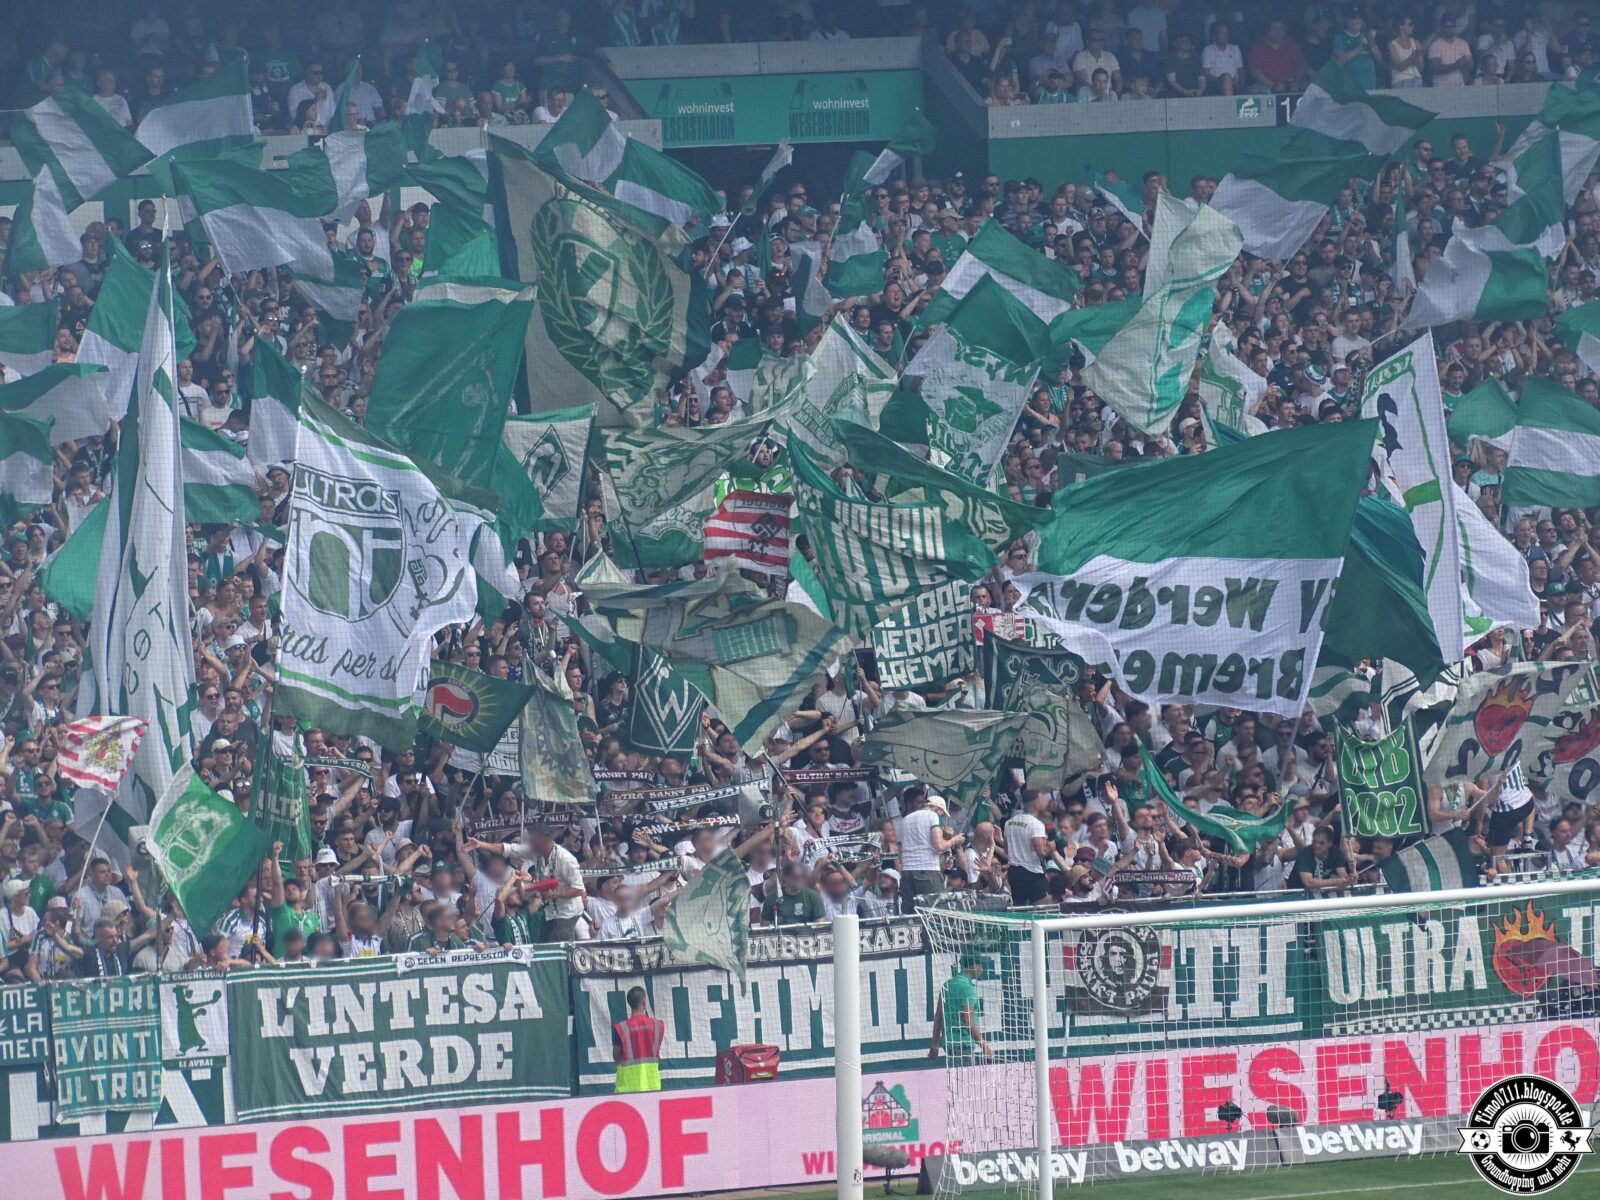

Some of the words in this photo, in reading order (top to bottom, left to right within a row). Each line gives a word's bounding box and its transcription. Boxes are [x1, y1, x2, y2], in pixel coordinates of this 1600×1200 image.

[678, 102, 734, 114] wohninvest
[813, 97, 870, 110] wohninvest
[664, 115, 735, 141] ESERSTADION
[451, 951, 509, 963] REPRESSION
[572, 946, 634, 974] OUR
[1324, 916, 1488, 1005] ULTRA
[52, 985, 158, 1018] SEMPRE
[257, 970, 542, 1038] L'INTESA
[55, 1030, 159, 1066] AVANTI
[289, 1031, 514, 1098] VERDE
[57, 1070, 161, 1106] ULTRAS
[55, 1096, 713, 1200] WIESENHOF
[1114, 1133, 1248, 1173] betway
[1298, 1120, 1424, 1157] betway
[950, 1149, 1088, 1185] betway
